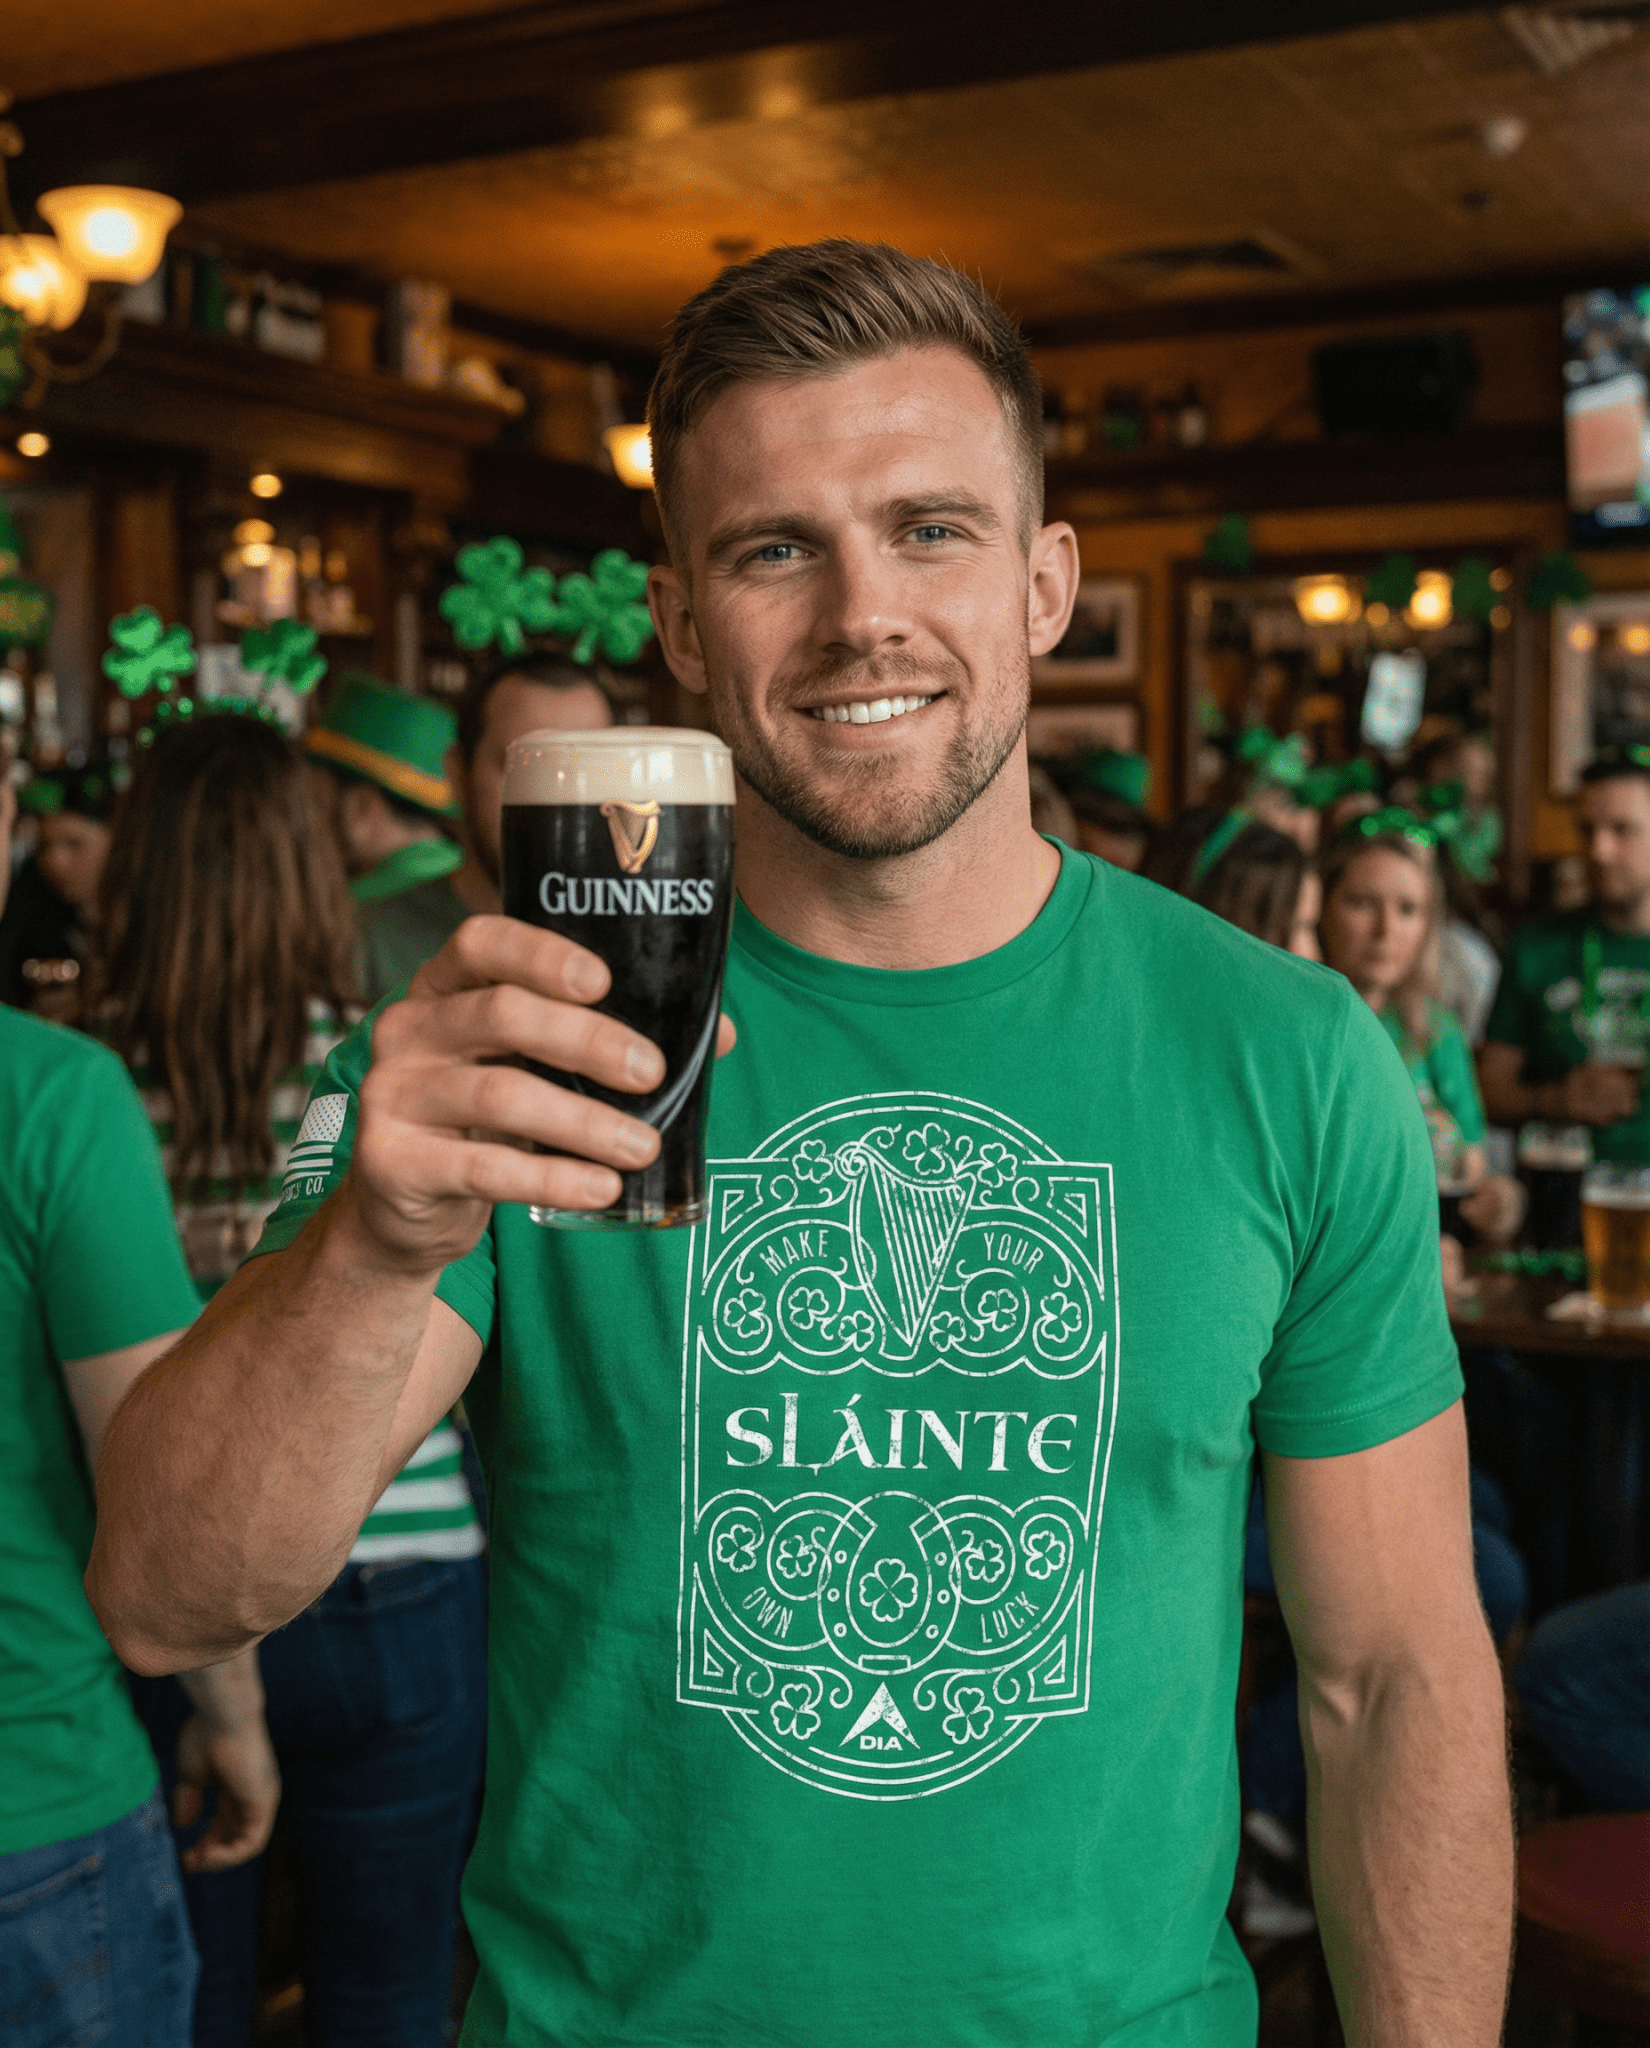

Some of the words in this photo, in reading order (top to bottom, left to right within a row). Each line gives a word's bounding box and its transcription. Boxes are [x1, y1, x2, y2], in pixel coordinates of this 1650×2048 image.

[539, 871, 715, 916] GUINNESS
[760, 1229, 828, 1276] MAKE
[983, 1232, 1045, 1275] YOUR
[725, 1392, 1077, 1476] SLÁINTE
[742, 1586, 793, 1639] OWN
[980, 1590, 1040, 1644] LUCK
[859, 1735, 904, 1751] DIA
